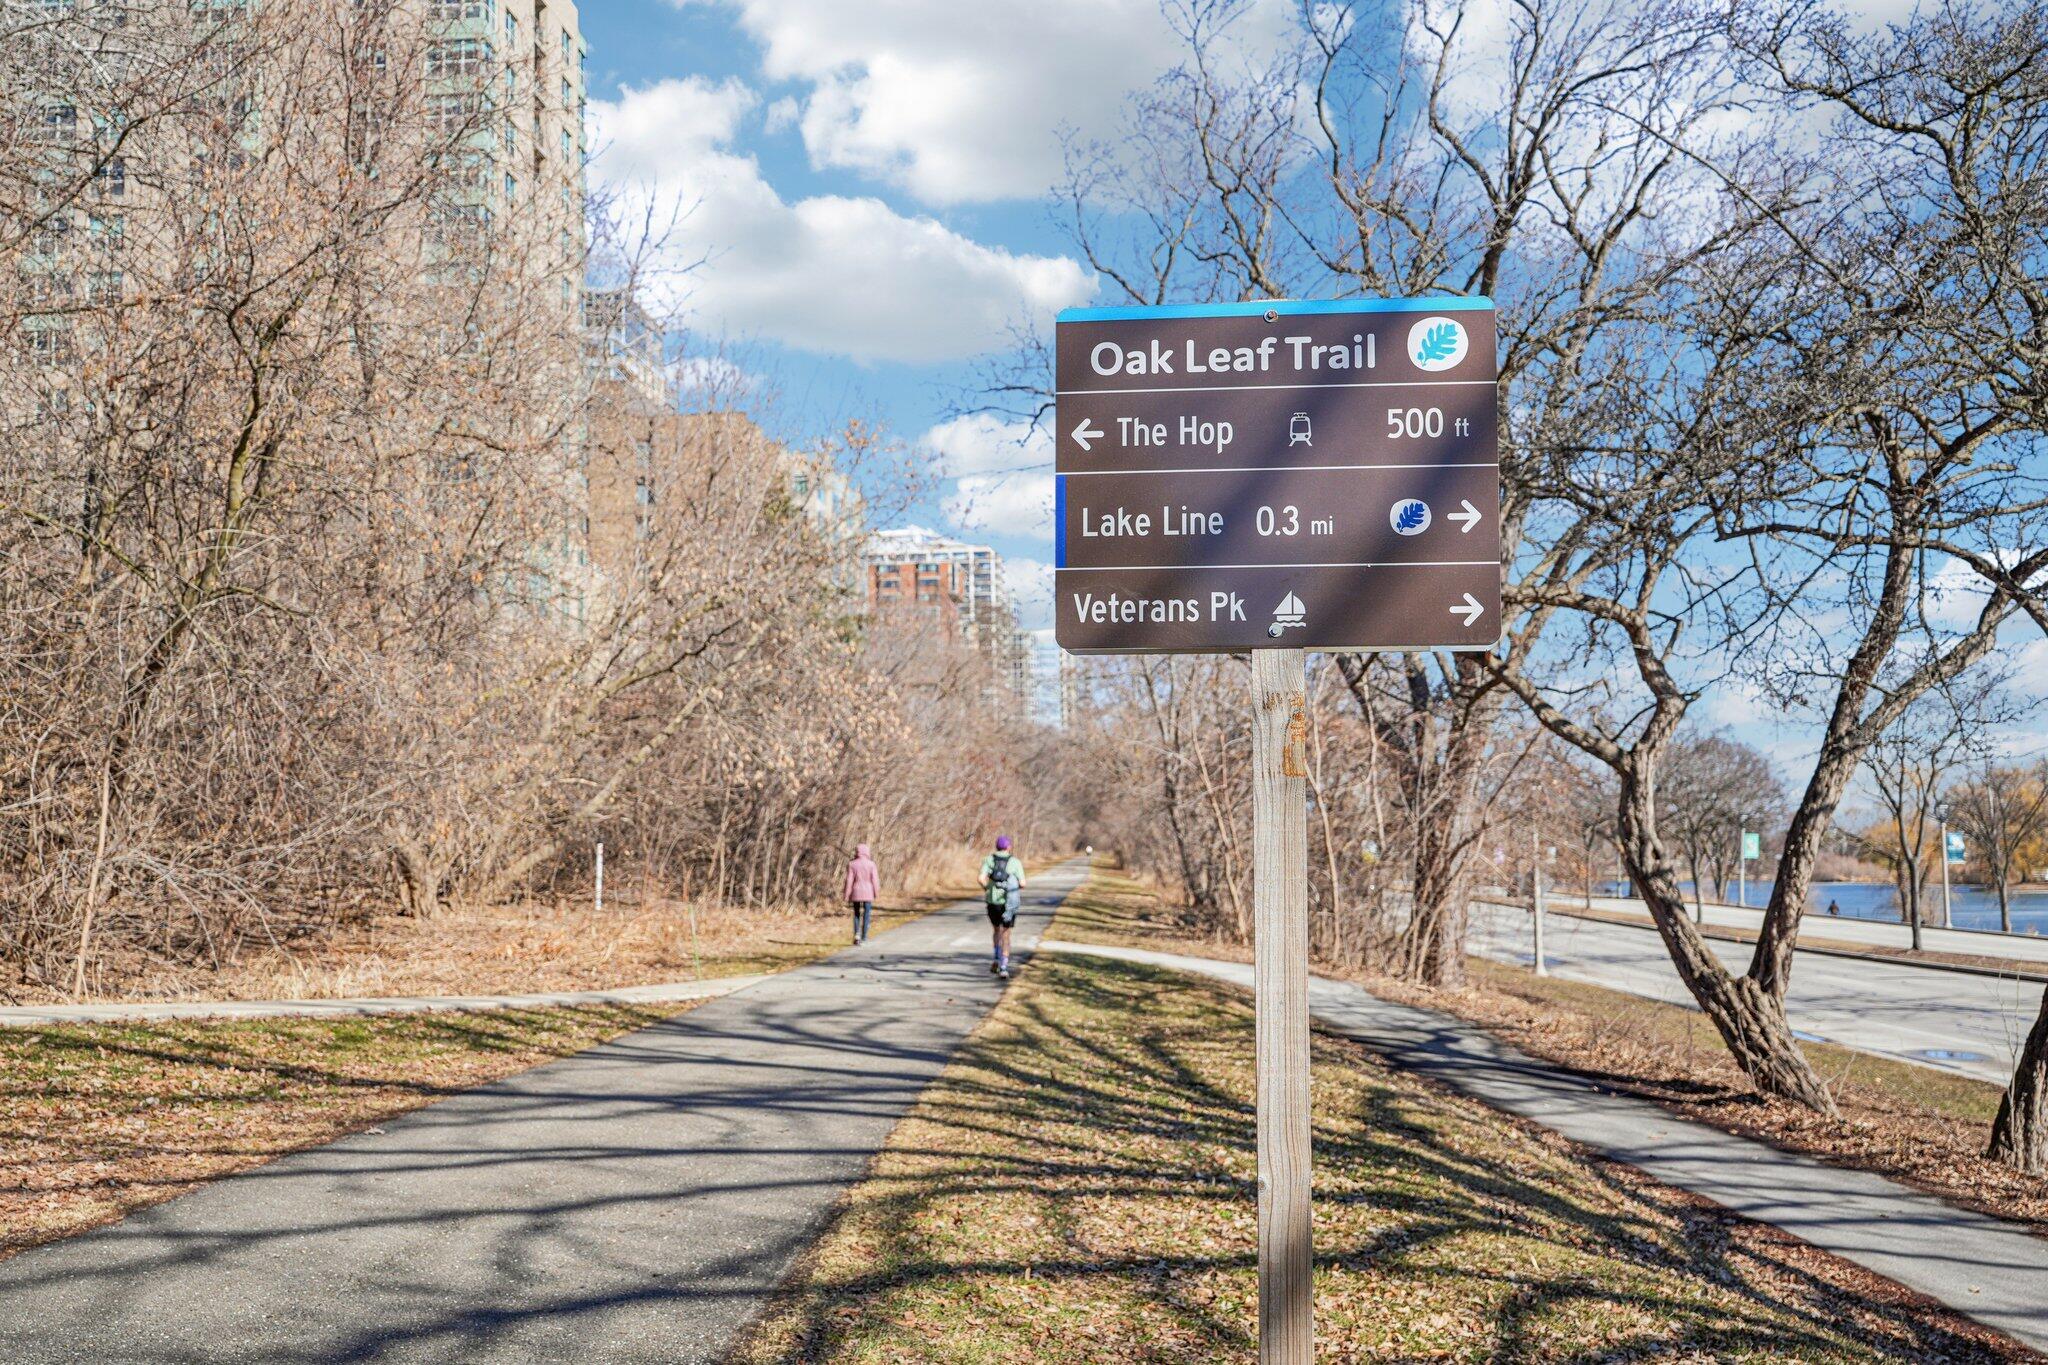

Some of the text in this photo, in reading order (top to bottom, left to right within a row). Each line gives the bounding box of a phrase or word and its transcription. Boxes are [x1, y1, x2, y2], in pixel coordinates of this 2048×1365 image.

[1090, 333, 1376, 376] Oak Leaf Trail
[1116, 407, 1470, 455] The Hop 500 ft
[1082, 504, 1334, 537] Lake Line 0.3 mi
[1073, 591, 1247, 624] Veterans Pk
